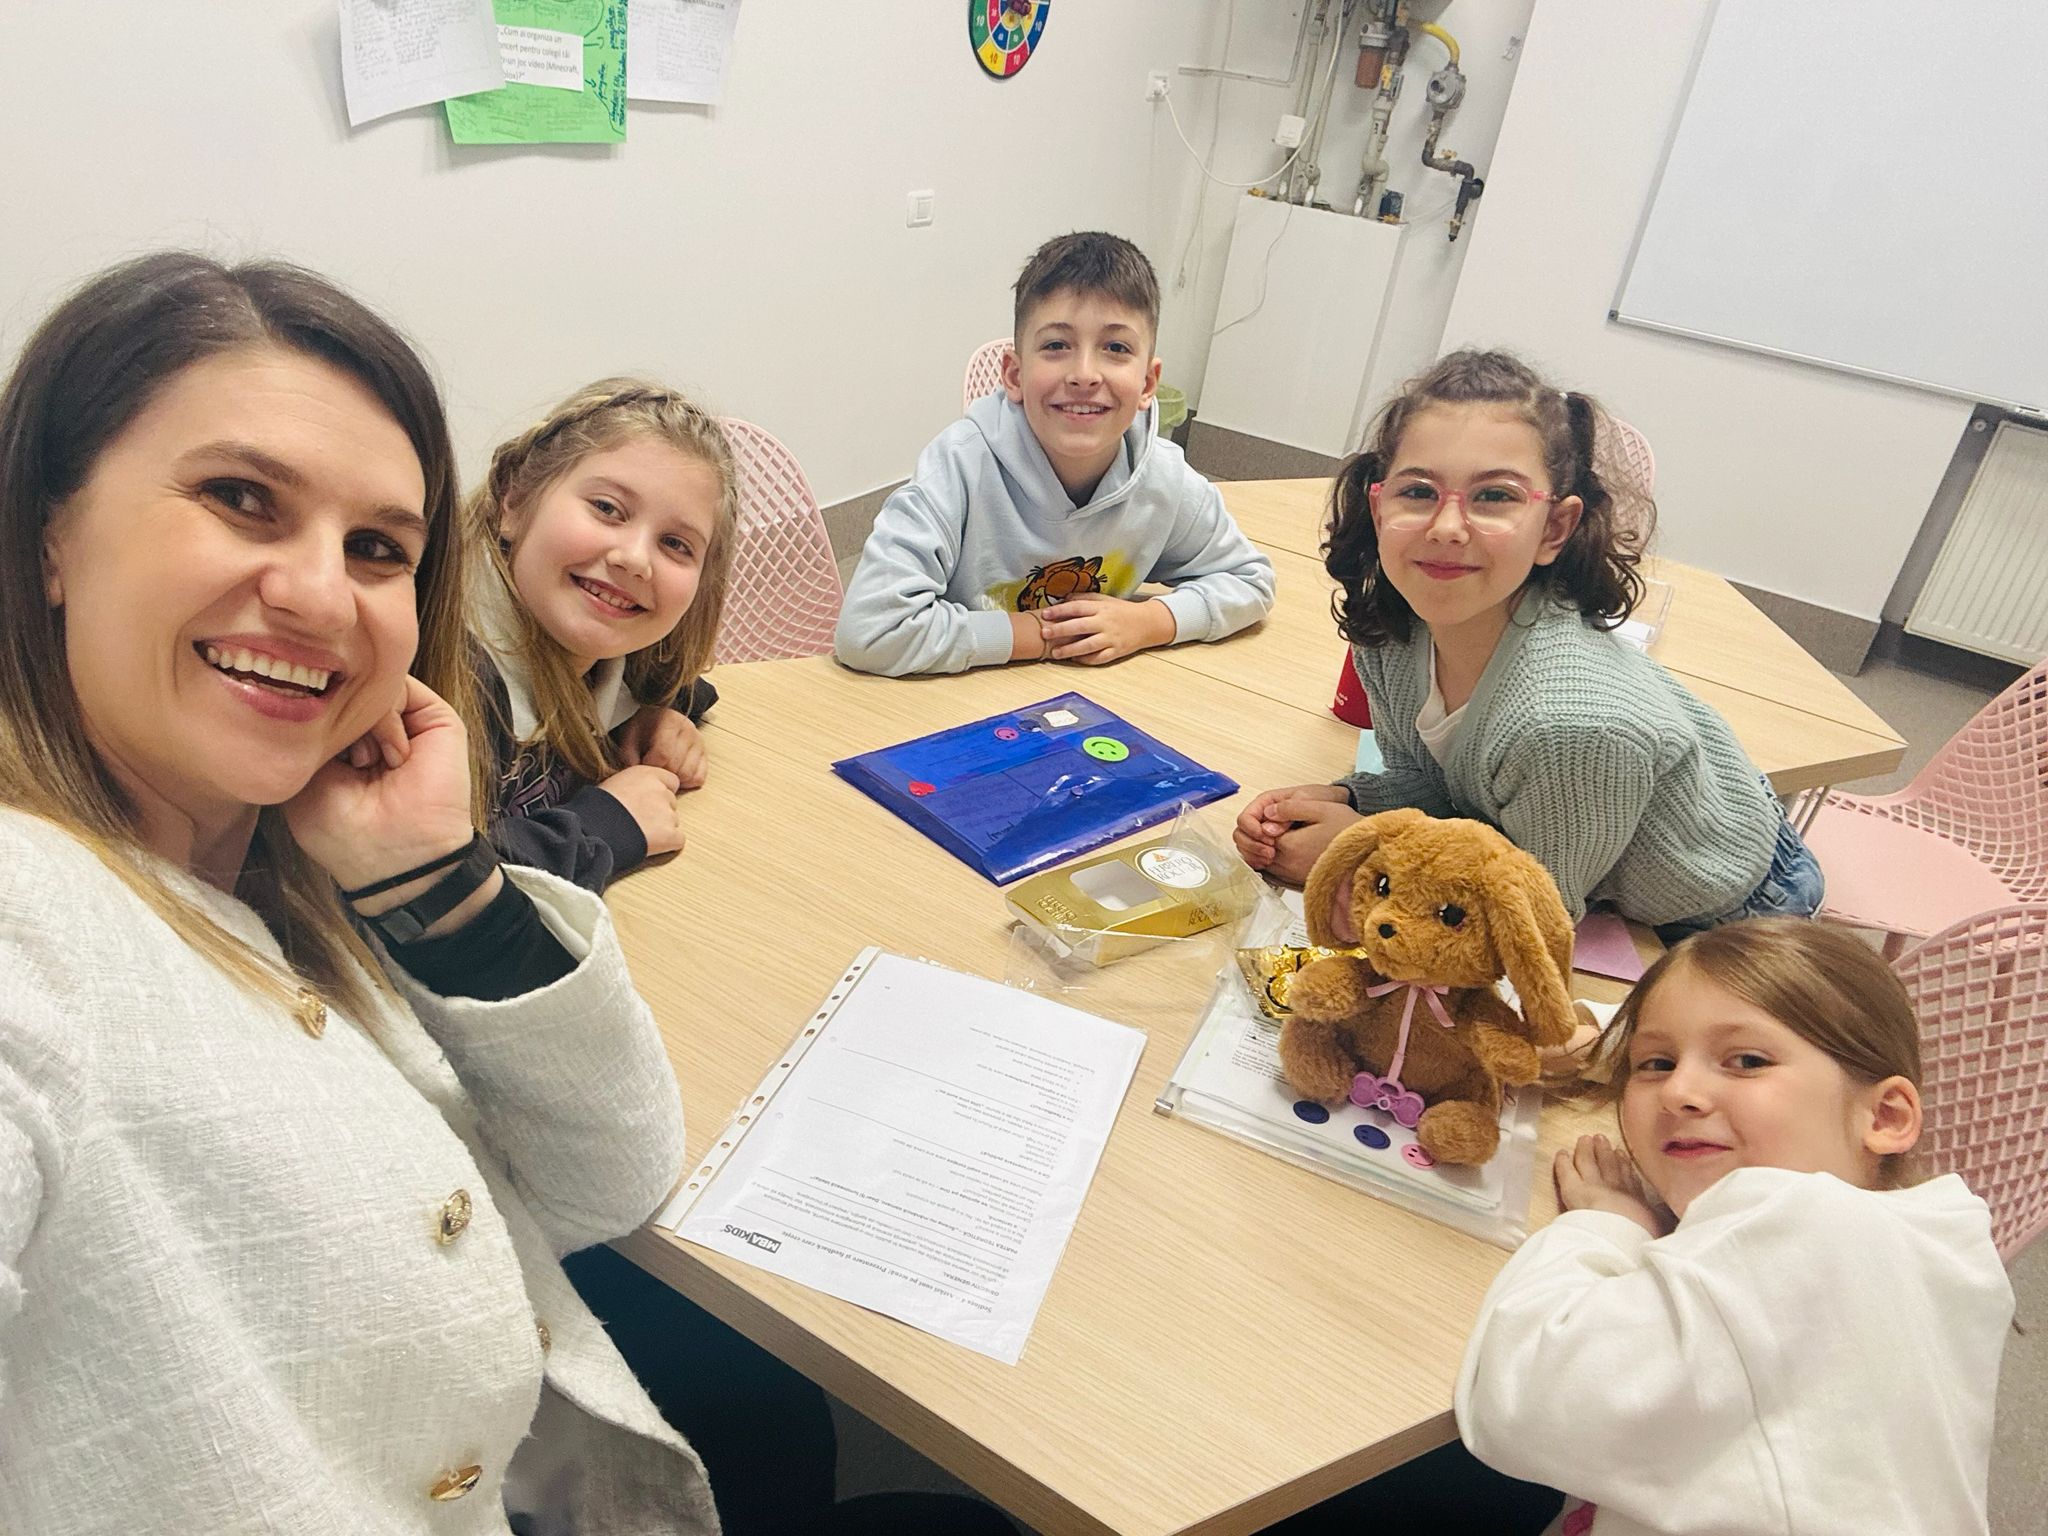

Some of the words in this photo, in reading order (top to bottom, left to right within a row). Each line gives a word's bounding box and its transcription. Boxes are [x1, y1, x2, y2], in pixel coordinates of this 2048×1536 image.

[975, 15, 985, 26] 10
[1035, 20, 1042, 31] 10
[526, 31, 553, 42] organiza
[498, 42, 518, 51] oncert
[519, 44, 541, 56] pentru
[542, 47, 561, 59] colegii
[517, 58, 527, 69] joc
[528, 60, 545, 70] video
[989, 52, 998, 64] 10
[1013, 54, 1021, 64] 10
[720, 1222, 752, 1241] KIDS
[746, 1231, 781, 1253] MBA
[799, 1237, 816, 1247] care
[994, 1241, 1018, 1254] PARTEA
[814, 1242, 845, 1258] feedback
[851, 1255, 888, 1273] Prezentare
[907, 1275, 919, 1284] pe
[941, 1270, 971, 1286] GENERAL
